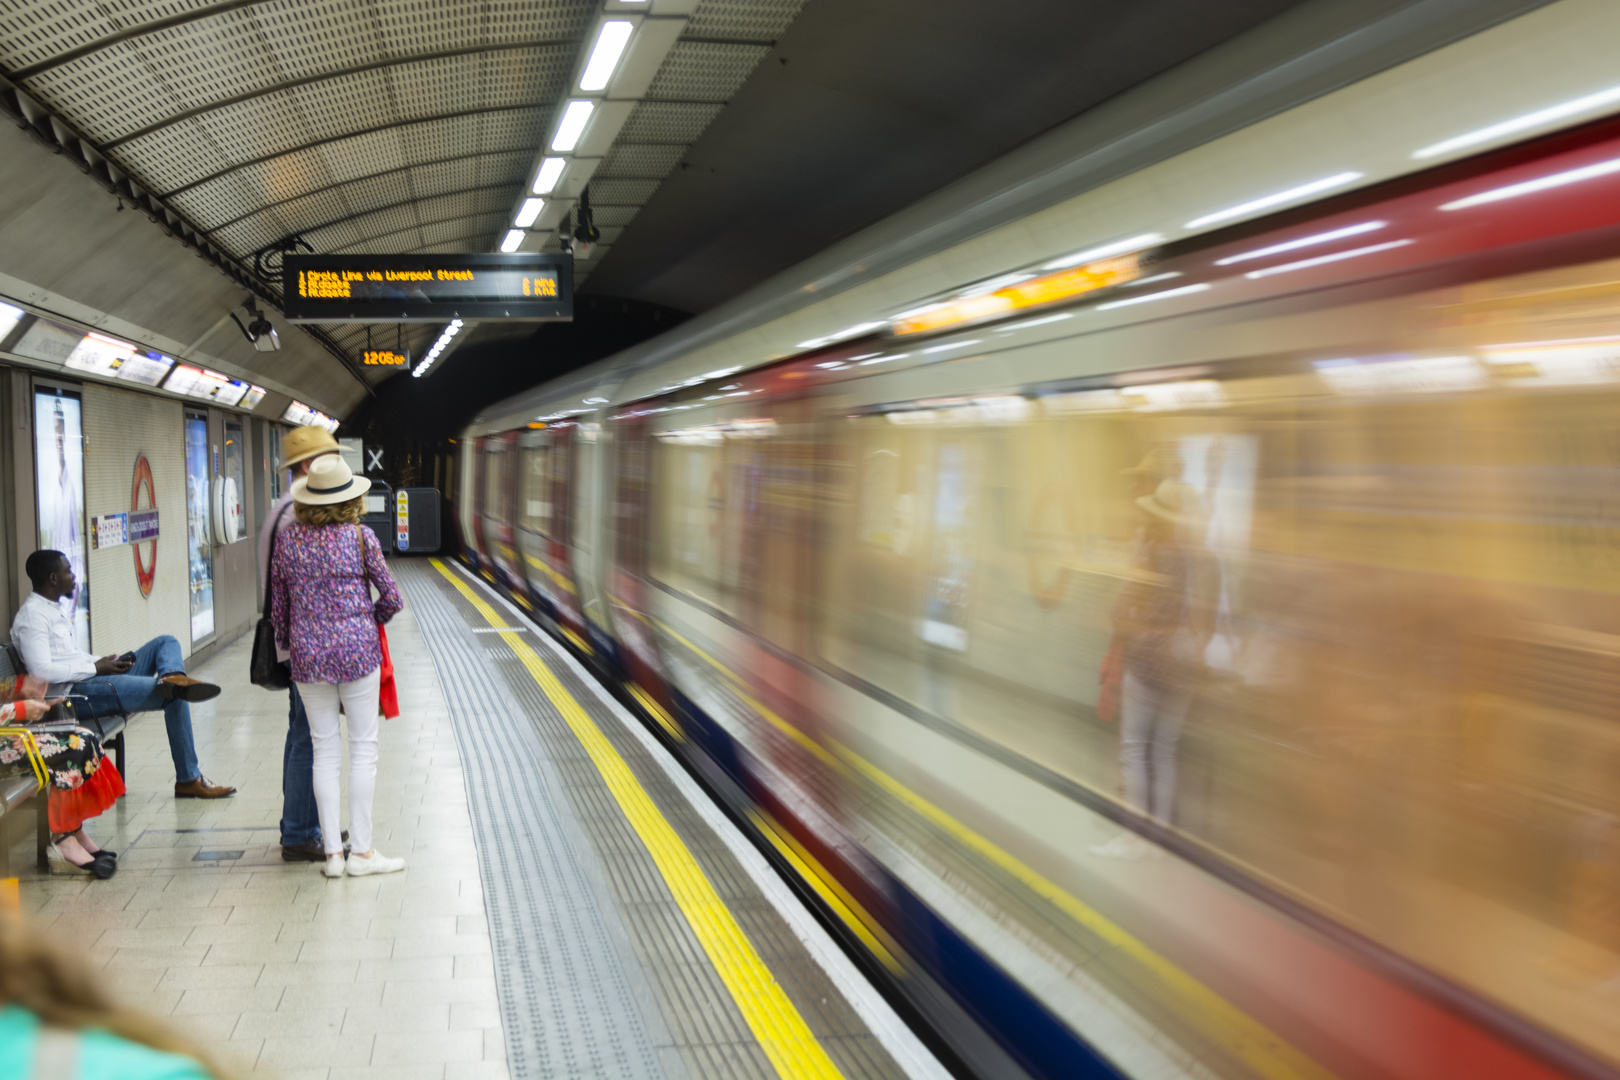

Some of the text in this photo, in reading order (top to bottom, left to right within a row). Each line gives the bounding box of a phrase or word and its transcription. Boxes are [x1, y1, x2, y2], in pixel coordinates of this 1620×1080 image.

[307, 270, 339, 281] Circle
[341, 270, 363, 281] Line
[366, 270, 383, 281] via
[386, 270, 434, 281] Liverpool
[437, 269, 474, 281] Street
[307, 280, 351, 290] Aldgate
[308, 289, 351, 298] Aldgate
